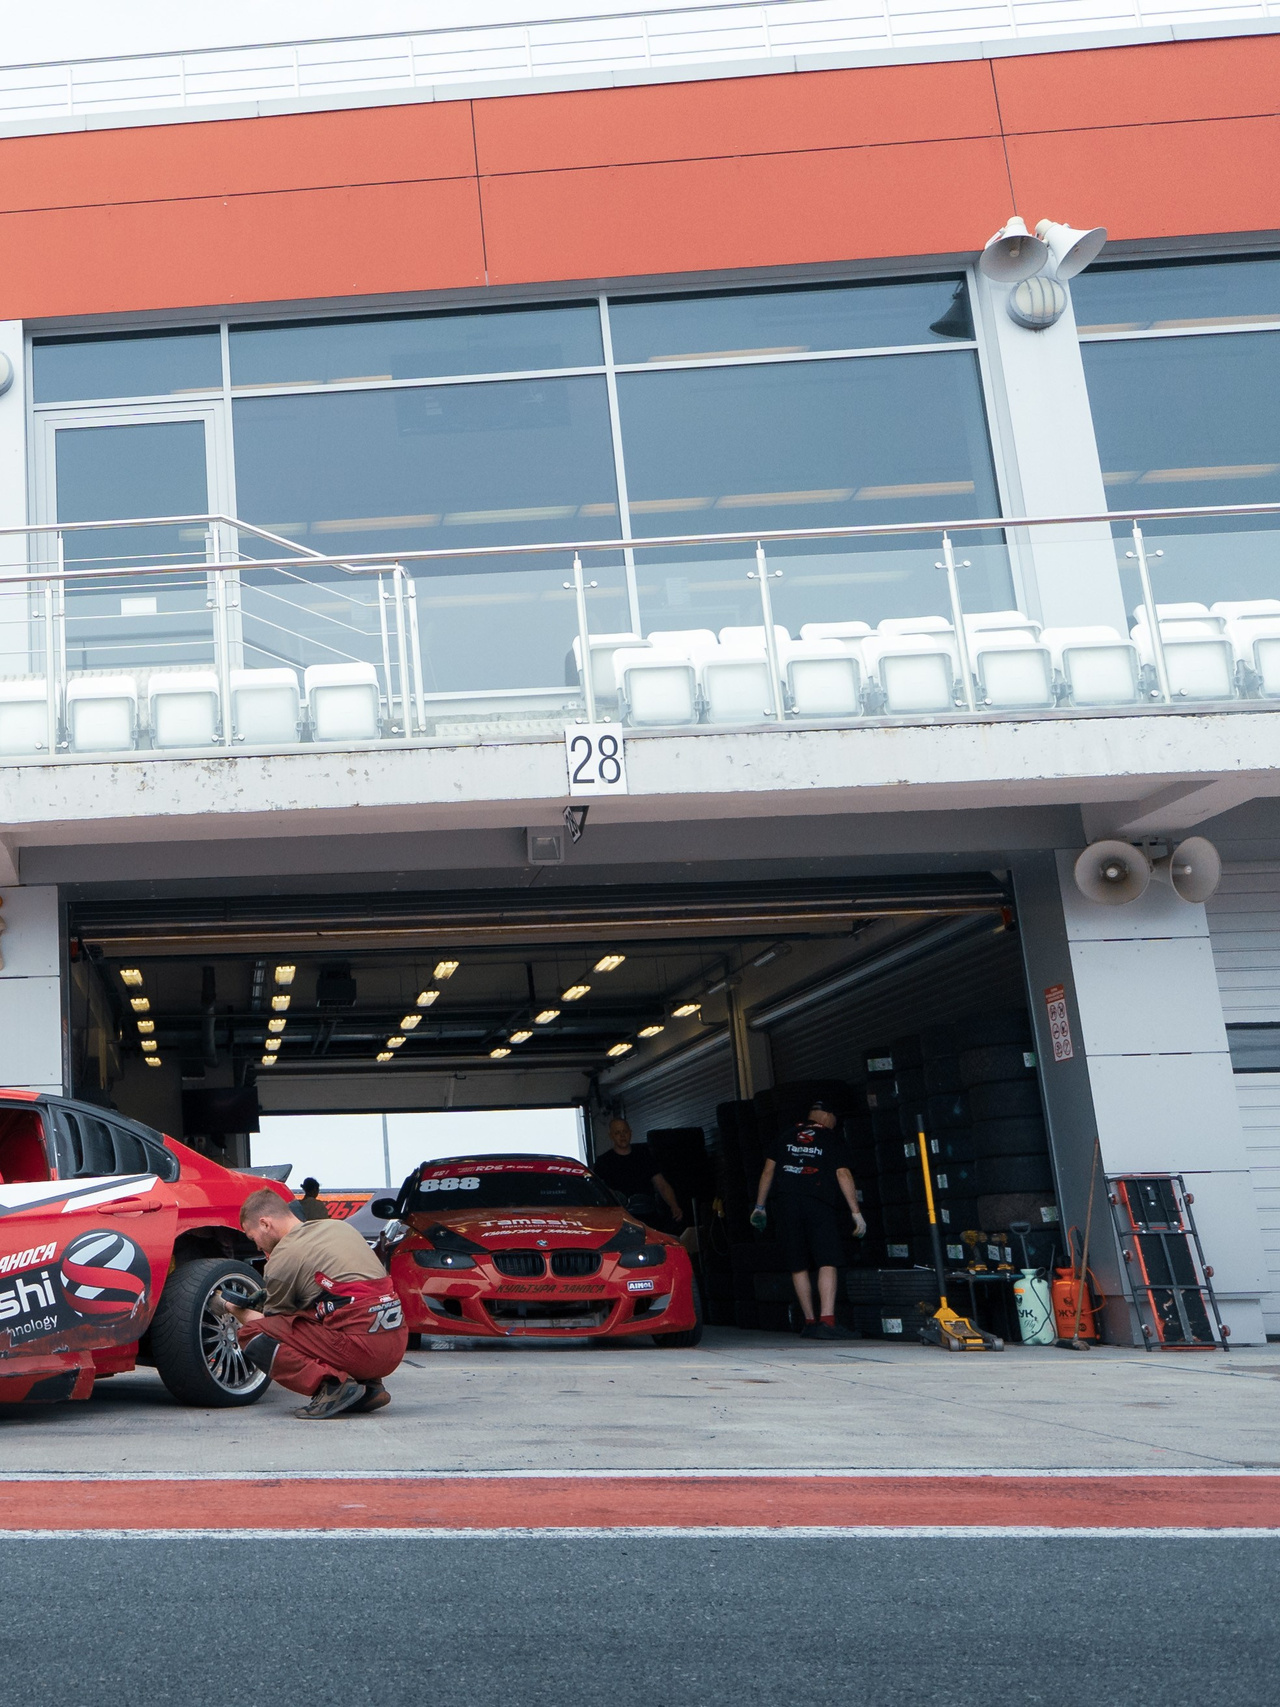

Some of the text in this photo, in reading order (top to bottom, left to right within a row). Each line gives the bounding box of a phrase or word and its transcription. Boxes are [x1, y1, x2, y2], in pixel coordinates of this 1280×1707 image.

[570, 735, 621, 784] 28
[546, 1165, 585, 1174] PRO
[419, 1176, 481, 1193] 888
[479, 1218, 583, 1227] Tamashi
[495, 1284, 606, 1294] КУЛЬТУРА ЗАНОСА
[1017, 1309, 1034, 1318] УК
[6, 1315, 58, 1338] hnology
